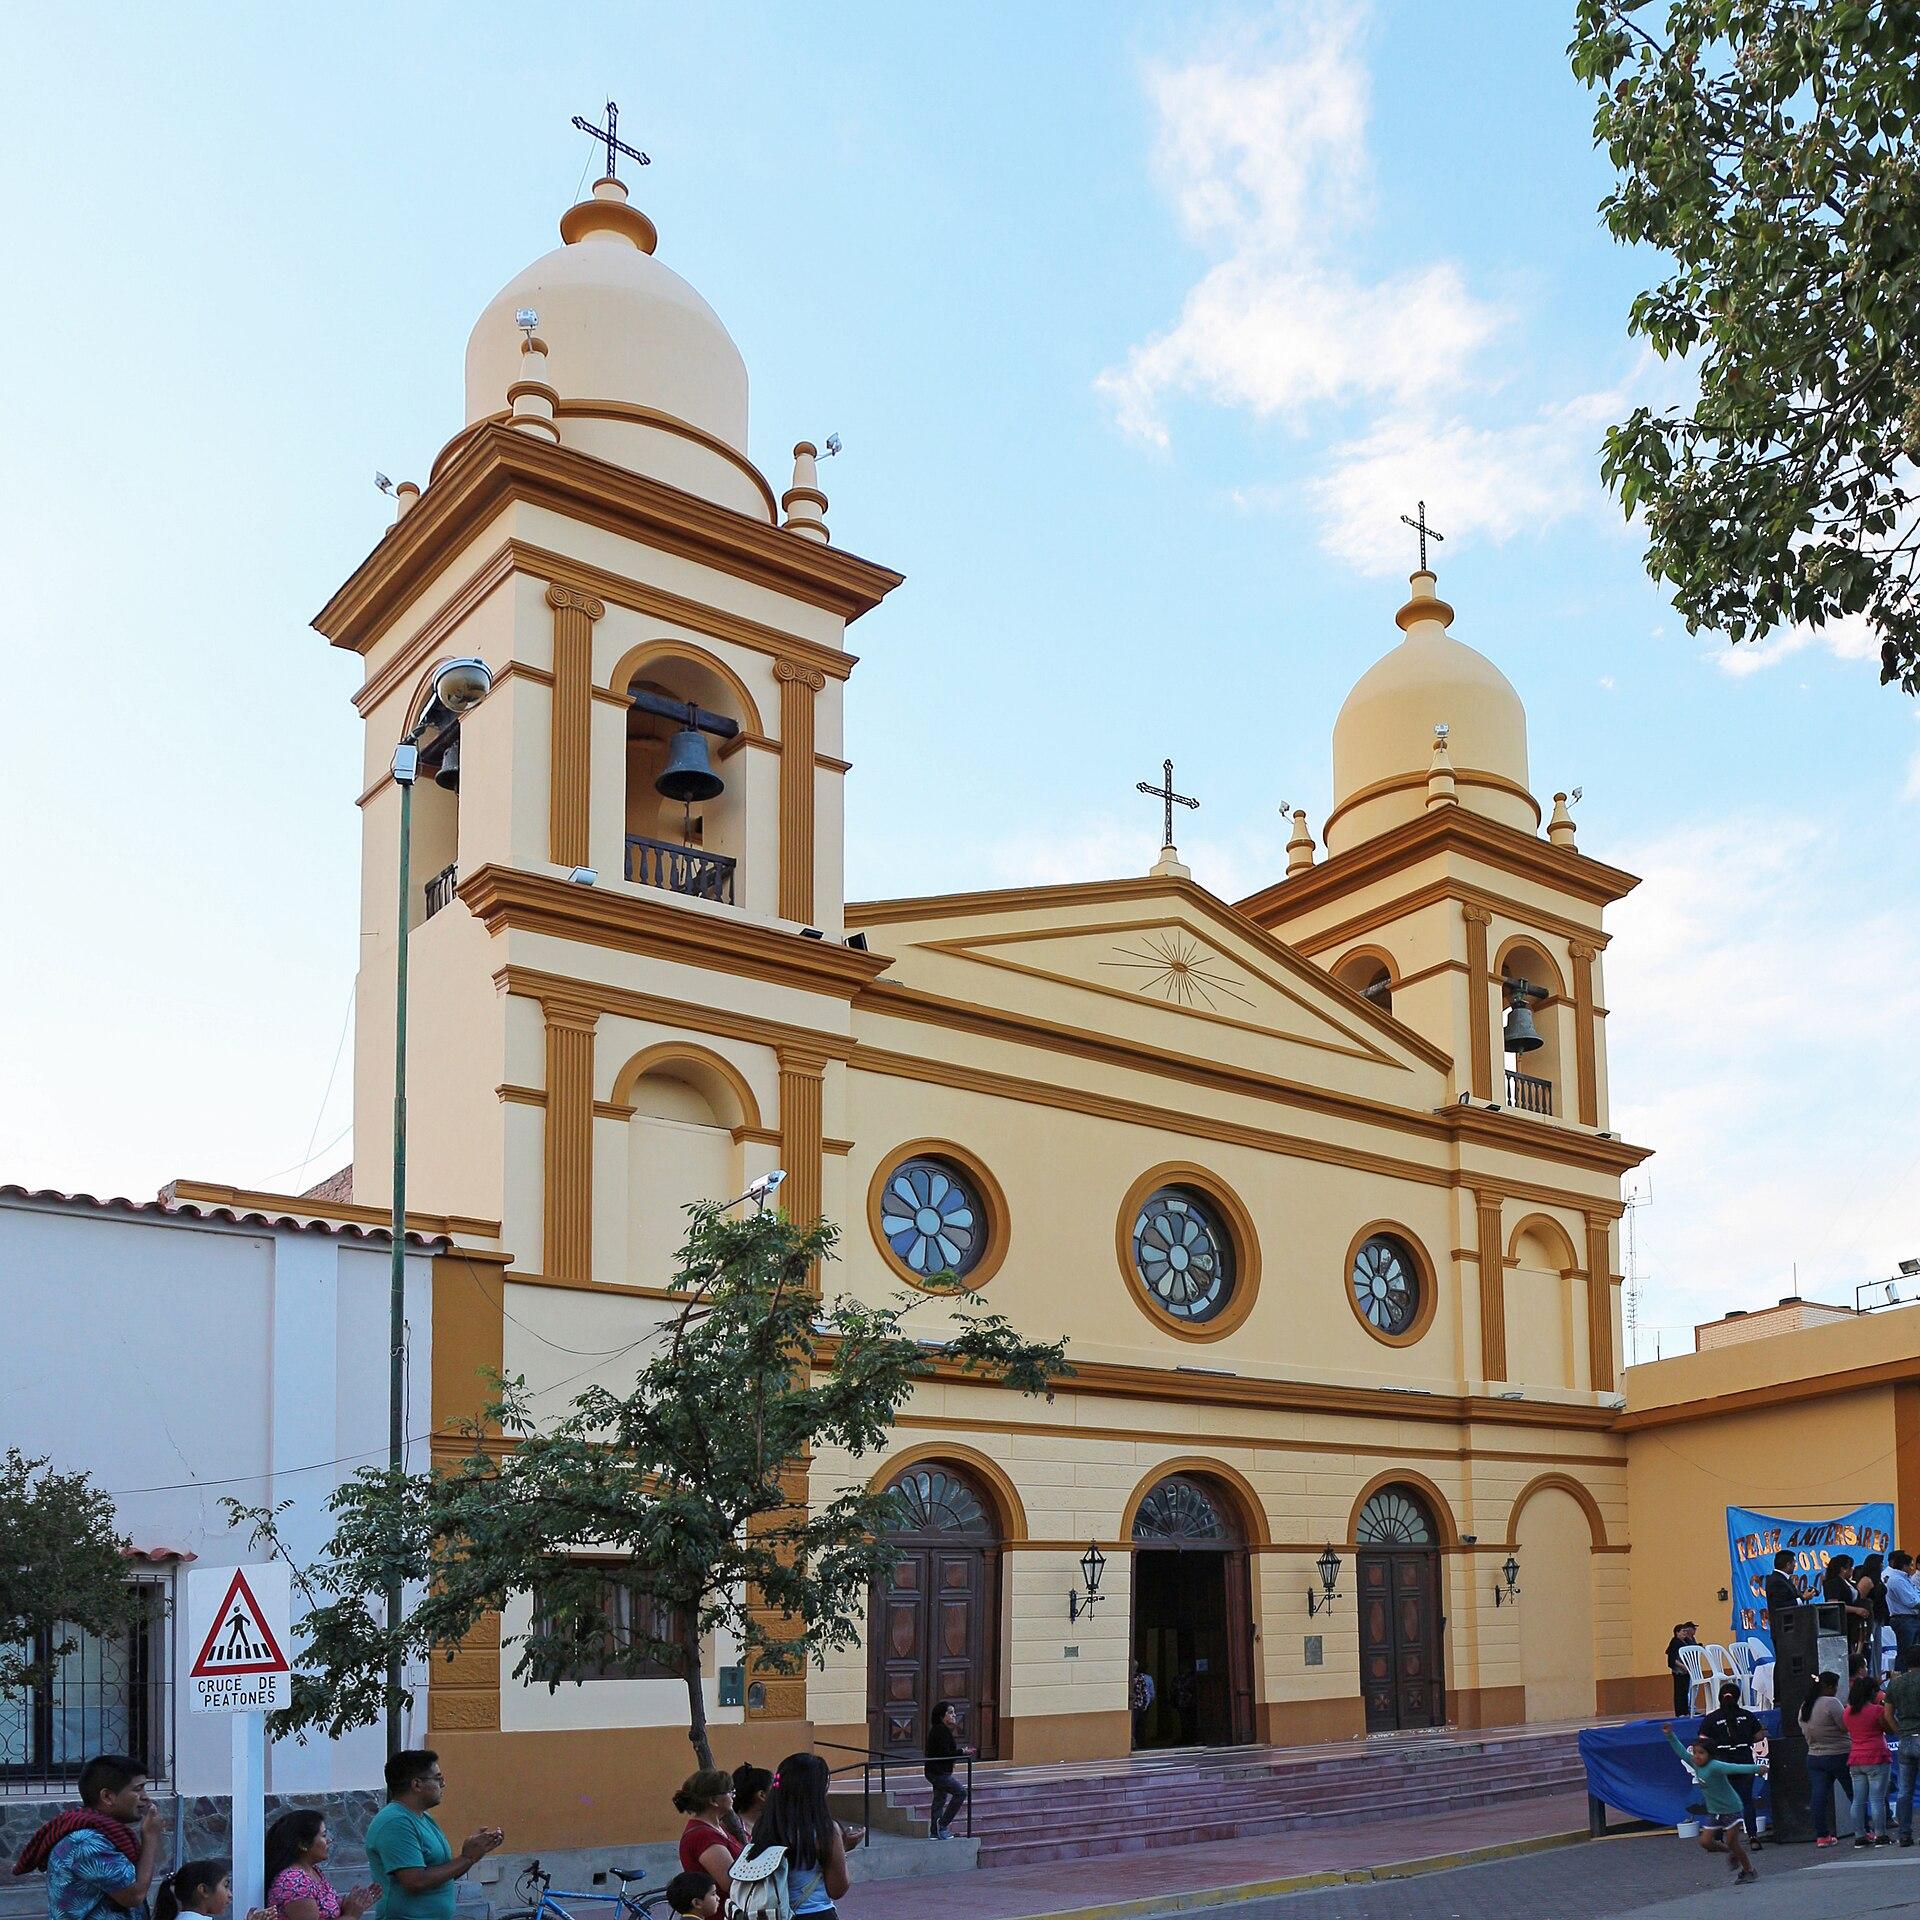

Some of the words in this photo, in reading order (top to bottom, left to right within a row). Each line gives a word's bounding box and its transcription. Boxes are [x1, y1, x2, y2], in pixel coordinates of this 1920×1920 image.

[1787, 1523, 1890, 1553] ANIVERSARIO
[198, 1677, 242, 1693] CRUCE
[259, 1676, 277, 1690] DE
[204, 1691, 276, 1708] PEATONES
